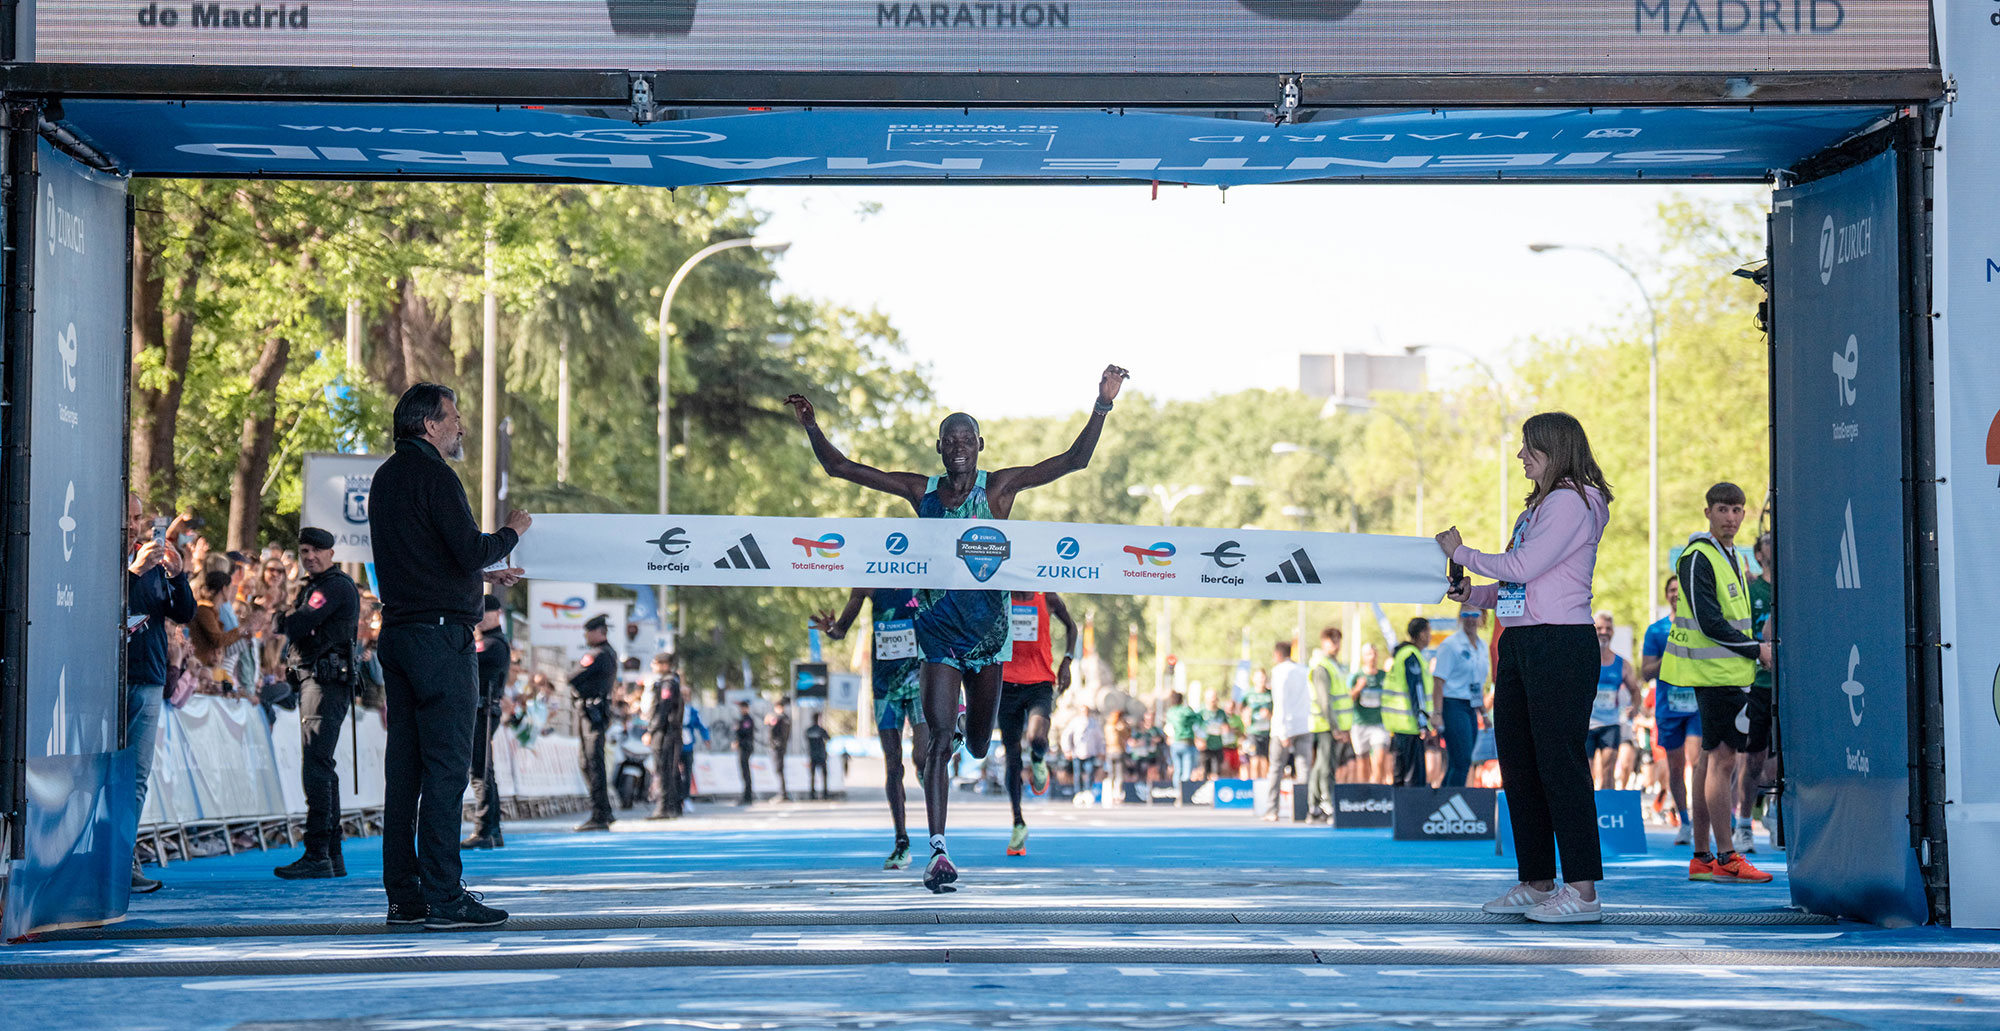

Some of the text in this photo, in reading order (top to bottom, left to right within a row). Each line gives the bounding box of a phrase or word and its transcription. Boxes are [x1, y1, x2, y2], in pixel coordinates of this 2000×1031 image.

[138, 2, 309, 29] de Madrid
[877, 3, 1069, 28] MARATHON
[1635, 0, 1845, 34] MADRID
[279, 124, 586, 139] MAPOMA
[1188, 131, 1530, 144] MADRID
[174, 143, 1743, 171] SIENTE MADRID
[57, 206, 85, 255] ZURICH
[1837, 217, 1871, 264] ZURICH
[647, 562, 690, 573] iberCaja
[791, 562, 845, 571] TotalEnergies
[866, 561, 928, 574] ZURICH
[1036, 565, 1099, 579] ZURICH
[1122, 570, 1176, 580] TotalEnergies
[1200, 574, 1244, 586] iberCaja
[1422, 820, 1488, 835] adidas
[694, 967, 1756, 979] ZURICH
